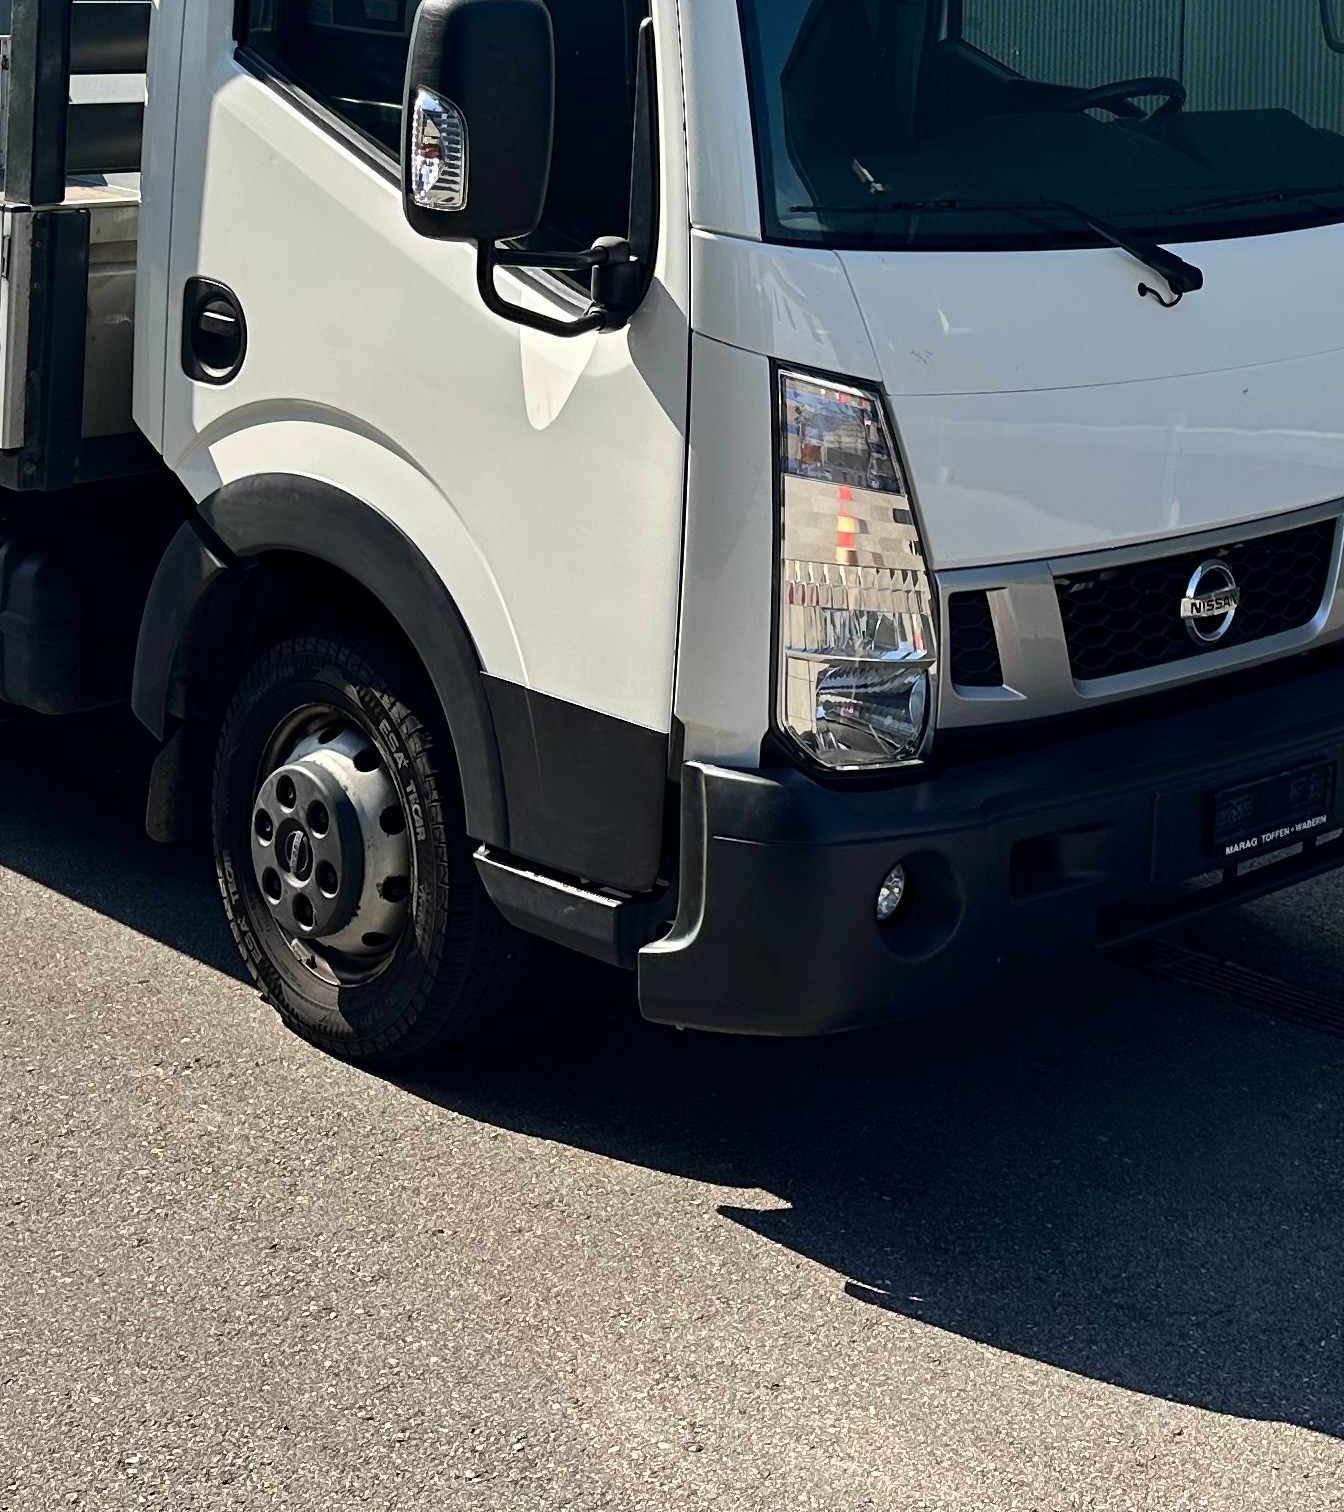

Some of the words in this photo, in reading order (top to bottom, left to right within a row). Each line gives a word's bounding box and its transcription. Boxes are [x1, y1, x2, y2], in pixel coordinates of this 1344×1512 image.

[1190, 594, 1236, 615] NISSAN
[1225, 837, 1258, 856] MARAG
[1261, 826, 1290, 843] TOFFEN
[1295, 814, 1327, 832] WABERN
